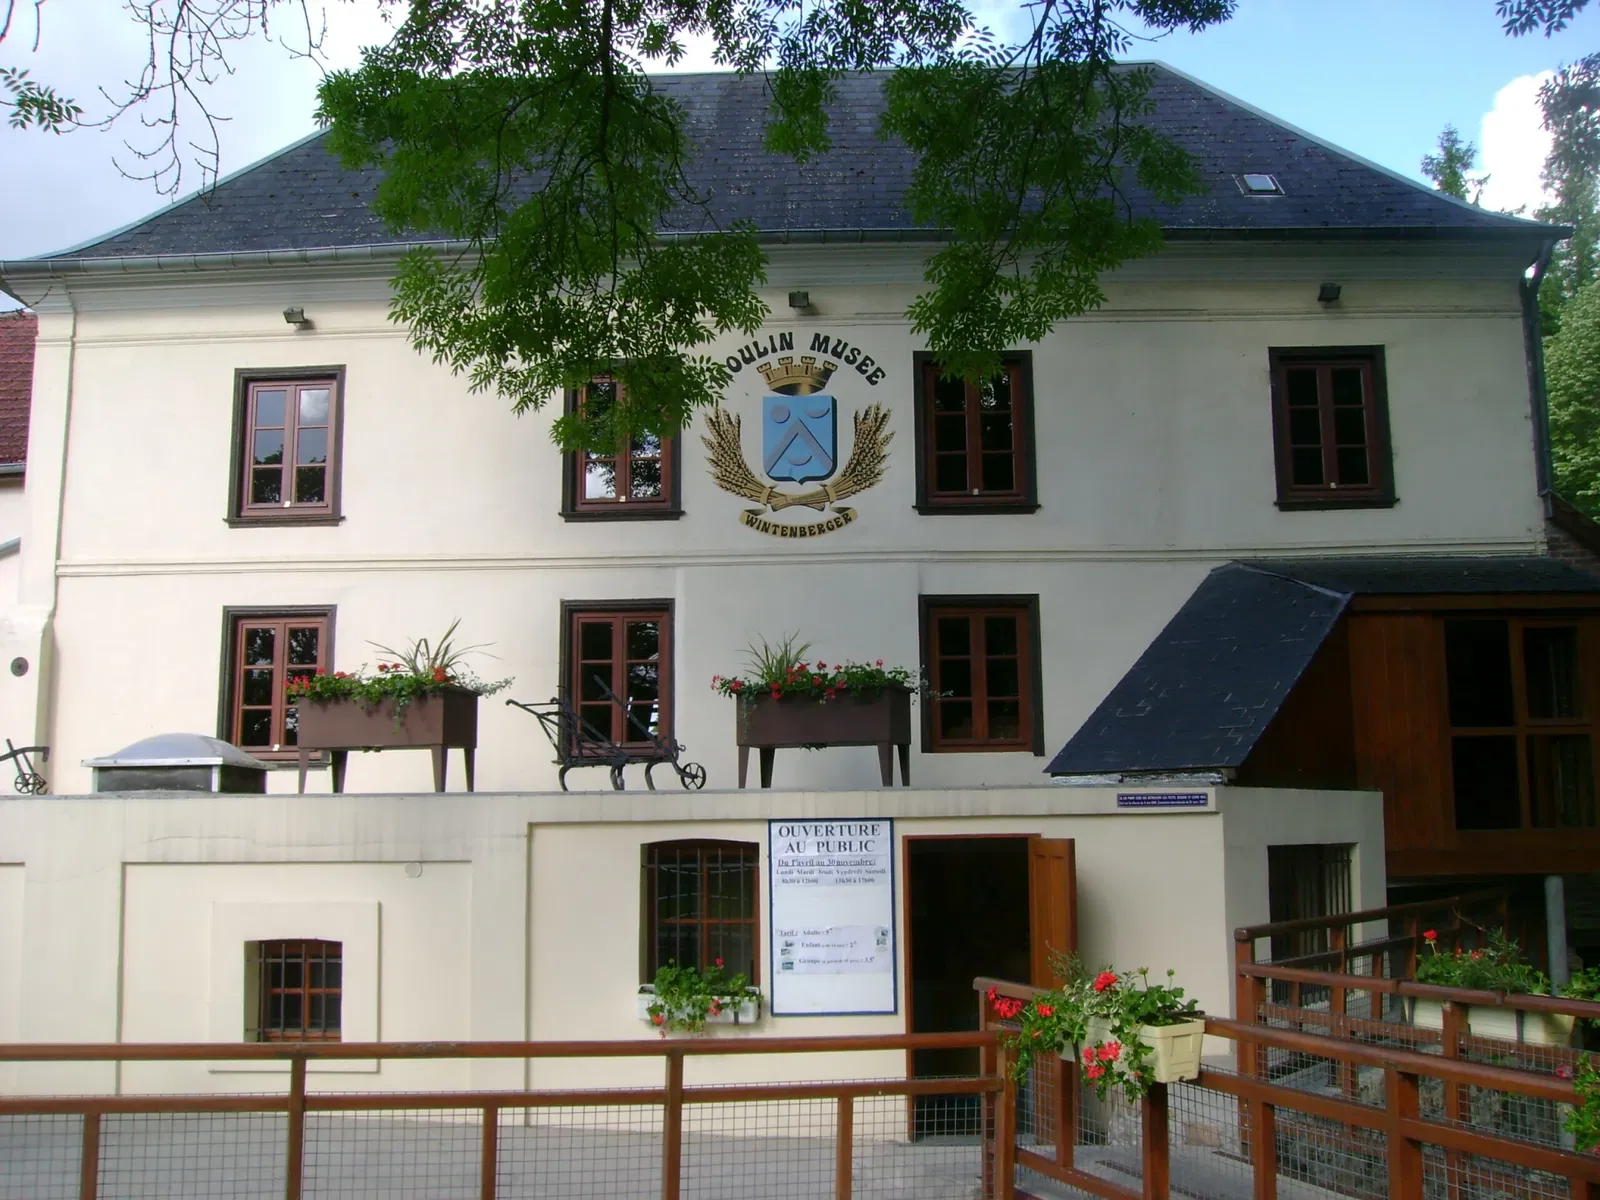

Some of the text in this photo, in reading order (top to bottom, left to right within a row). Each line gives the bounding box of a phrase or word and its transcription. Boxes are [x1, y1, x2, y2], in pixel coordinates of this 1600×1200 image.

[719, 332, 886, 386] OULIN MUSEE
[745, 512, 852, 538] WINTENBERGER
[778, 824, 881, 838] OUVERTURE
[785, 840, 876, 853] AU PUBLIC
